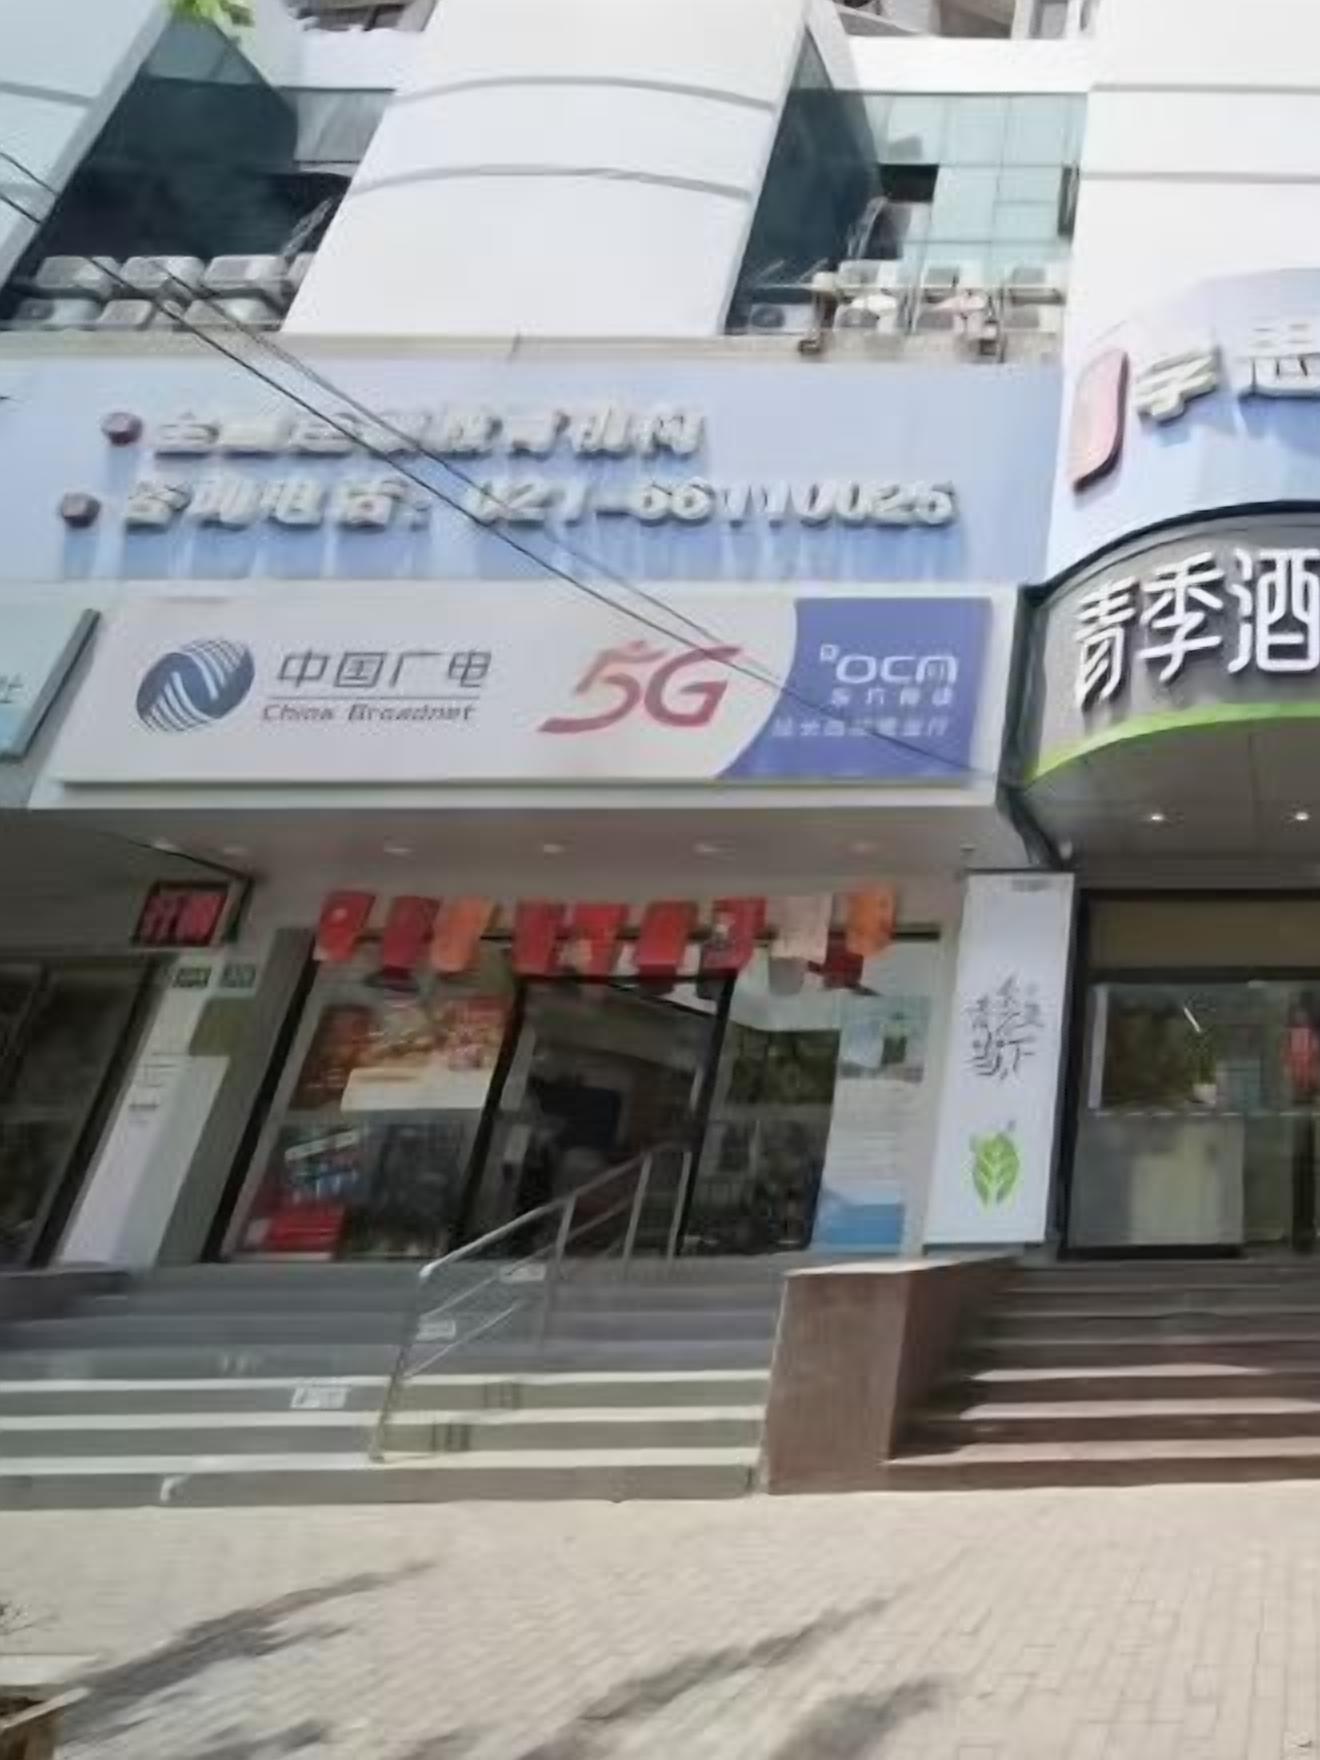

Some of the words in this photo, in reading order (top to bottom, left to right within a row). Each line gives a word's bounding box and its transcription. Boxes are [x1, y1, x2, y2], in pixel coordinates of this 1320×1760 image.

[276, 650, 492, 689] 中国广电
[536, 640, 742, 734] 5G
[263, 703, 336, 722] China
